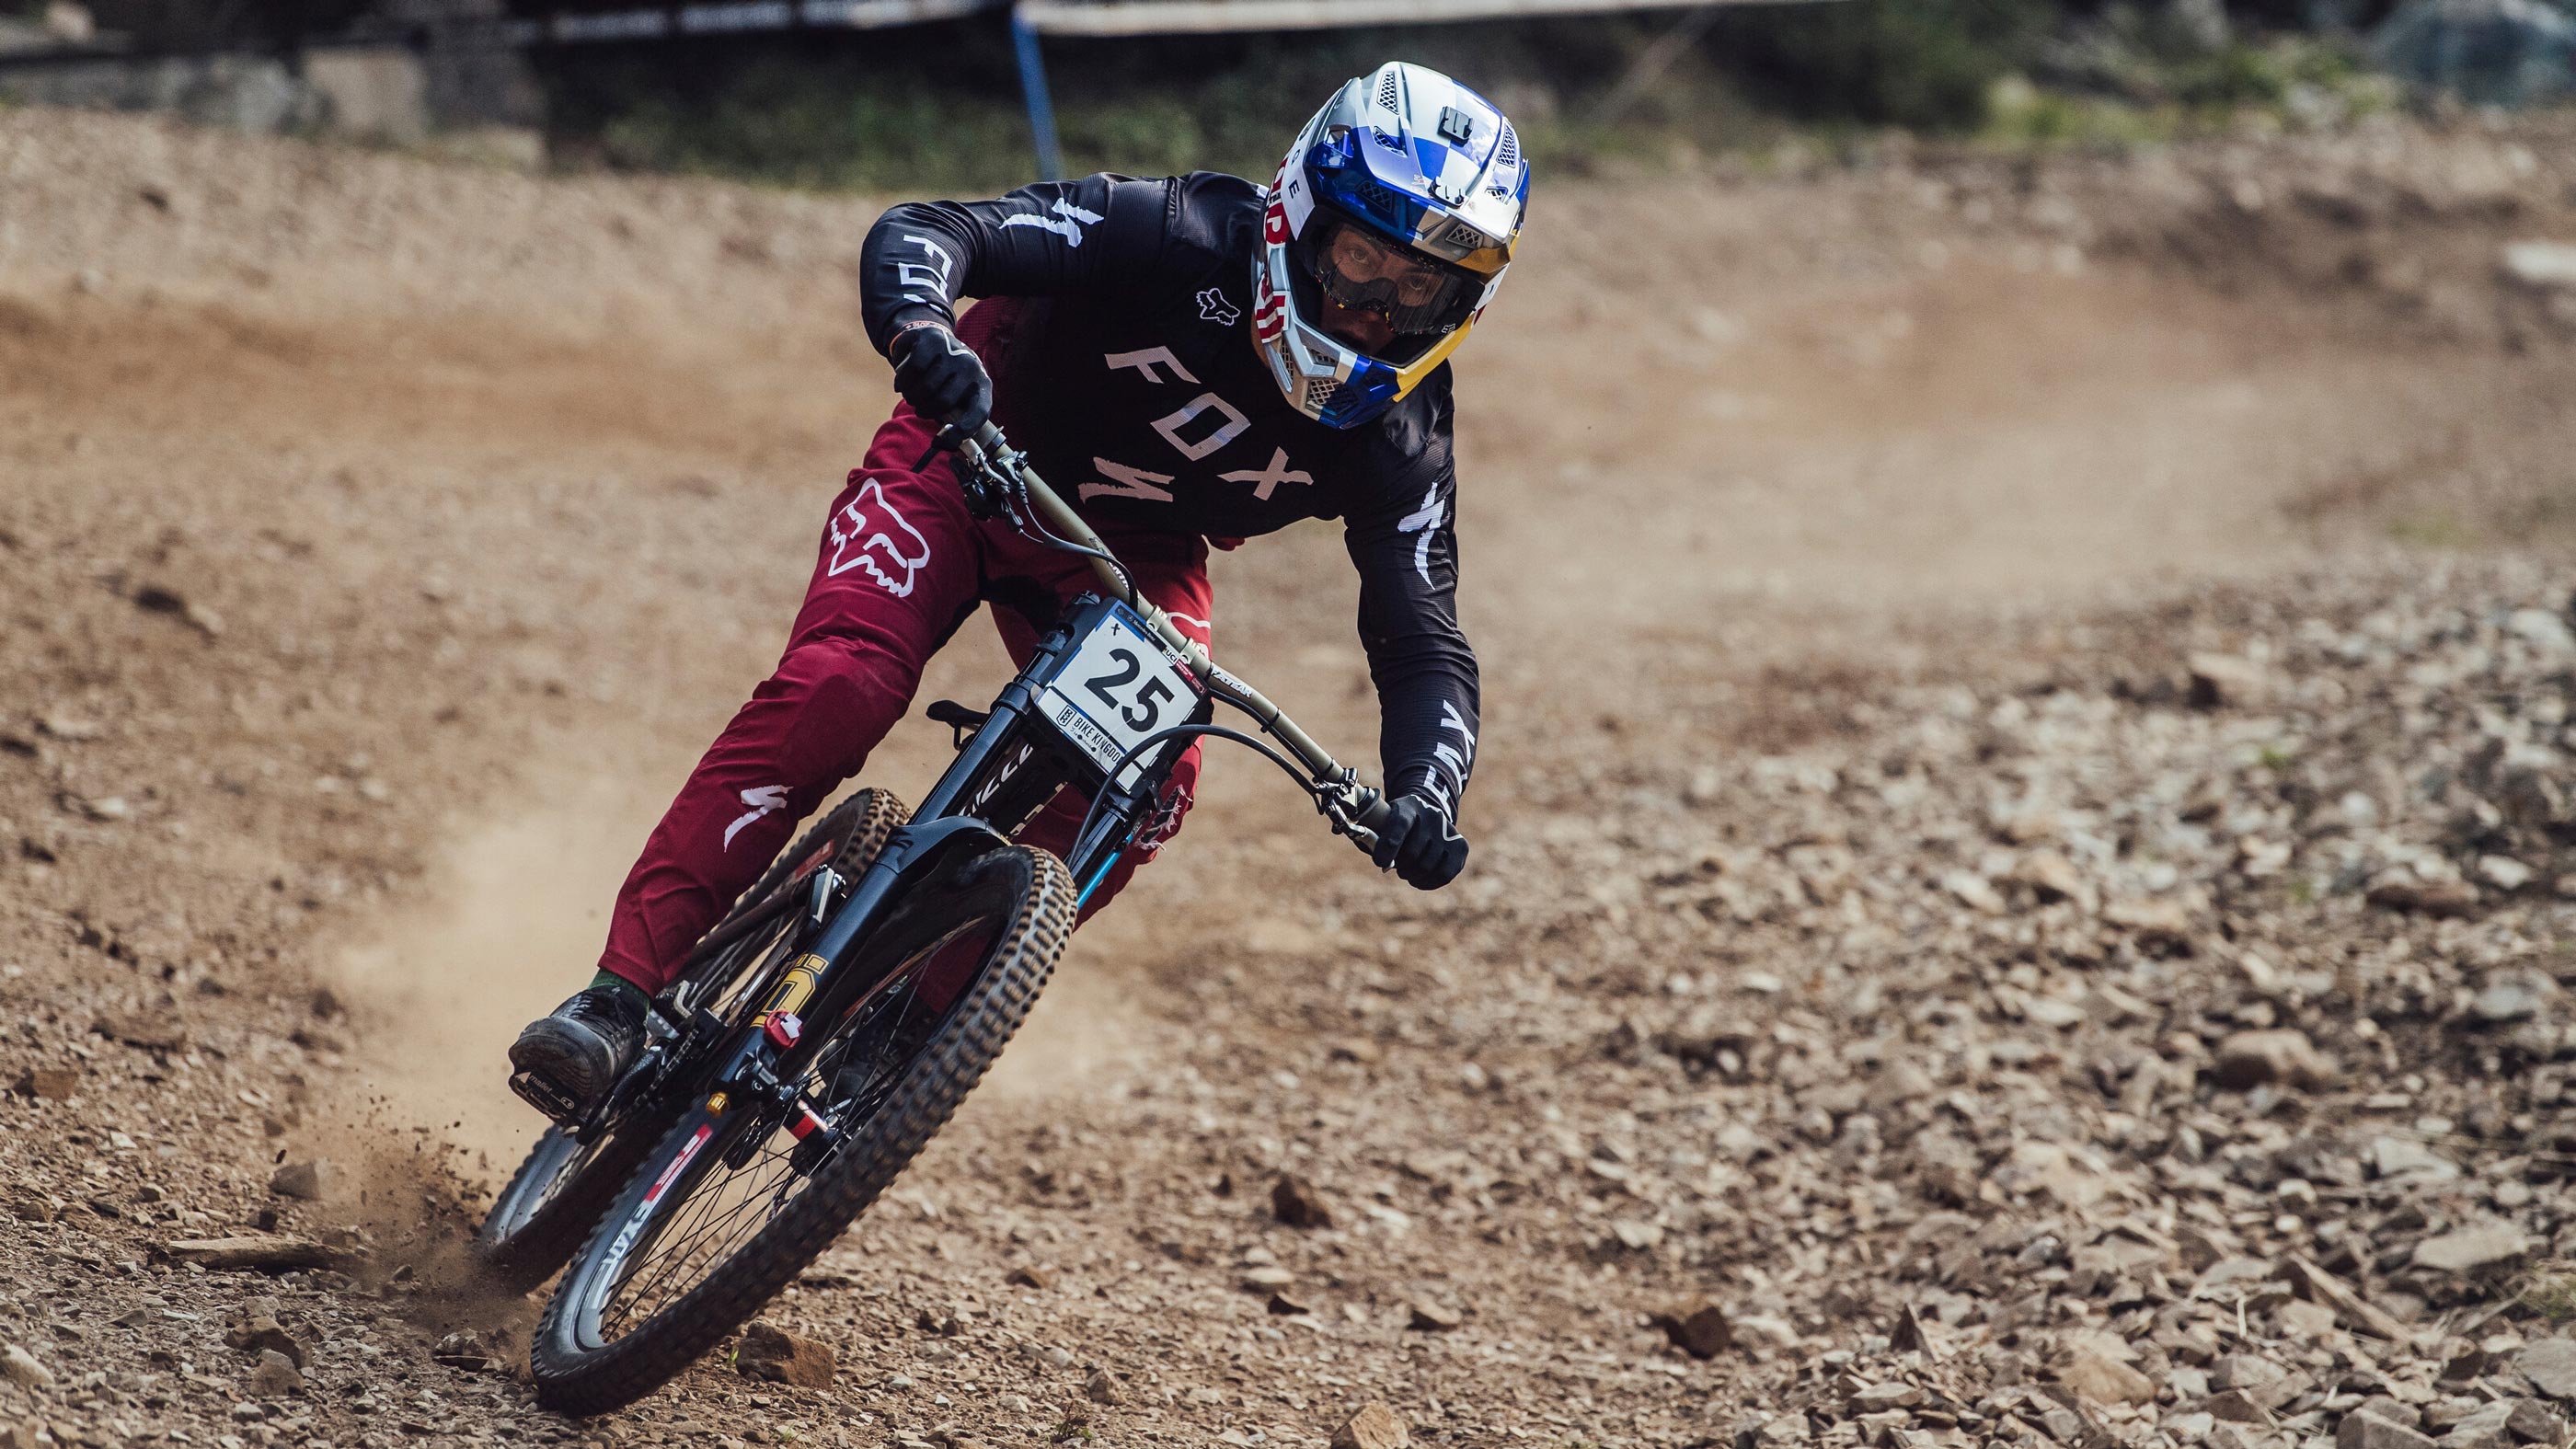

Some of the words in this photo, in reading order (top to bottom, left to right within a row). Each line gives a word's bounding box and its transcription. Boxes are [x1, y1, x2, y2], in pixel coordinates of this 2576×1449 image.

[1104, 345, 1314, 501] FOX
[1165, 648, 1179, 664] UCI
[1084, 647, 1175, 733] 25
[1074, 718, 1094, 738] BIKE
[1092, 733, 1123, 764] KINGDO
[528, 1075, 554, 1093] mallet
